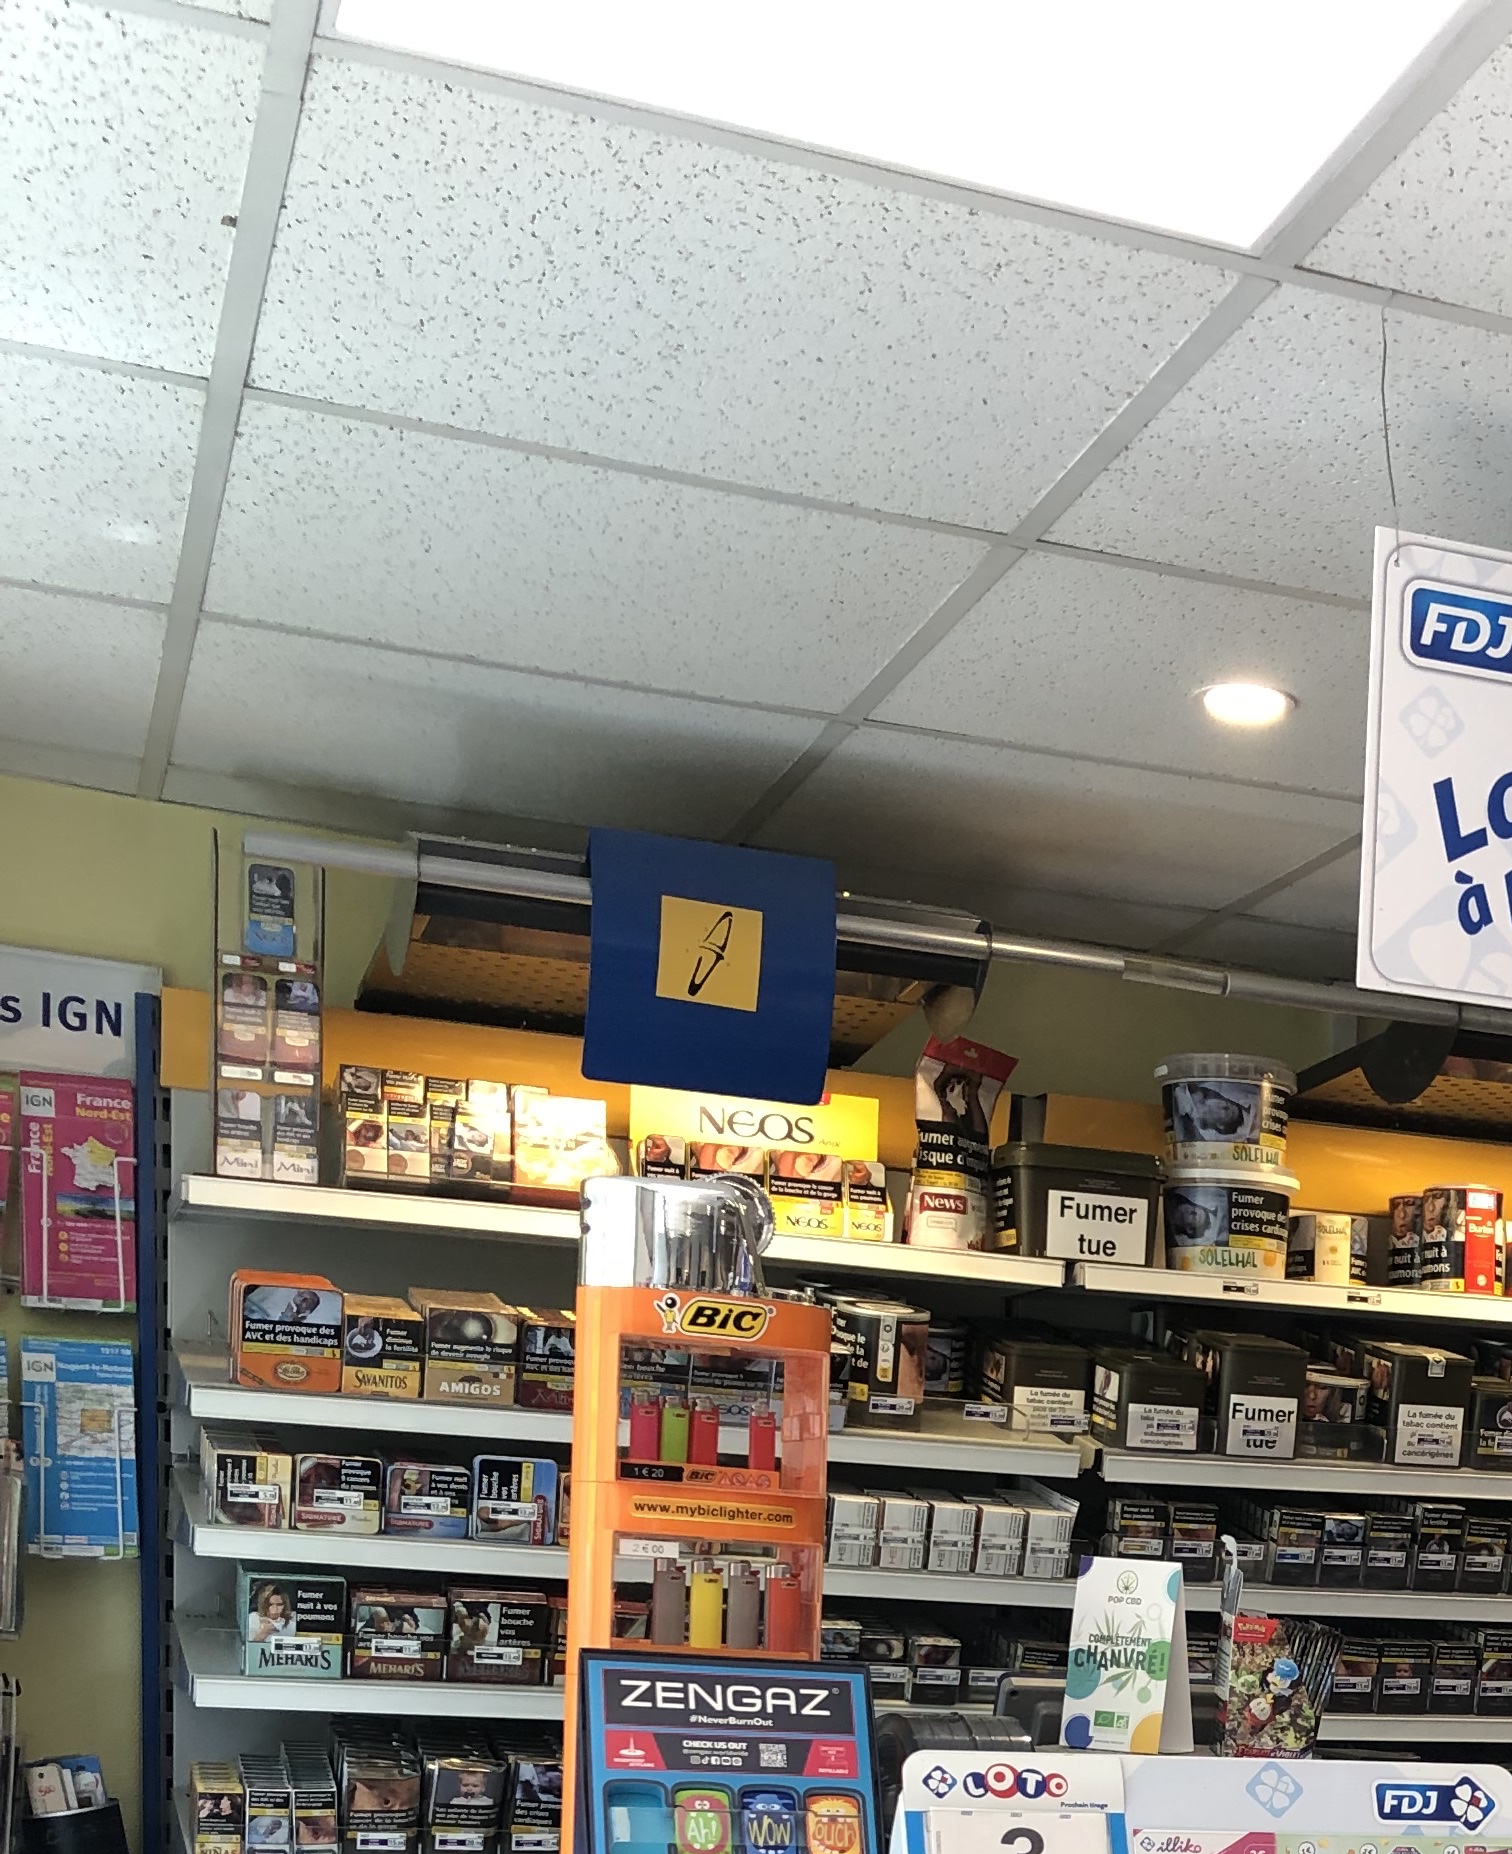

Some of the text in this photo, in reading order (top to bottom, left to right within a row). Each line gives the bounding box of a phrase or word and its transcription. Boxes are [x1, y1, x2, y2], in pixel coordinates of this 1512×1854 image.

[1457, 869, 1493, 936] à
[41, 991, 122, 1038] IGN
[25, 1094, 53, 1107] IGN
[76, 1092, 132, 1109] France
[75, 1107, 131, 1121] Nord-Est
[700, 1105, 815, 1145] NEOS
[923, 1193, 965, 1211] News
[1060, 1195, 1138, 1224] Fumer
[1078, 1233, 1117, 1257] tue
[245, 1320, 335, 1336] Fumer provoque des
[245, 1330, 339, 1347] AVC handicaps
[439, 1381, 501, 1397] AMIGOS
[300, 1512, 342, 1523] SIGNATURE
[633, 1501, 794, 1525] www.mybiclighter.com
[1108, 1595, 1142, 1606] POP CBD
[1088, 1633, 1152, 1647] COMPLÈTEMENT
[620, 1679, 832, 1716] ZENGAZ
[689, 1714, 774, 1727] #NeverBurnOut
[682, 1740, 748, 1750] CHECK US OUT
[963, 1763, 1069, 1798] LOTO
[1382, 1789, 1439, 1815] FDJ
[1156, 1835, 1203, 1854] illiko
